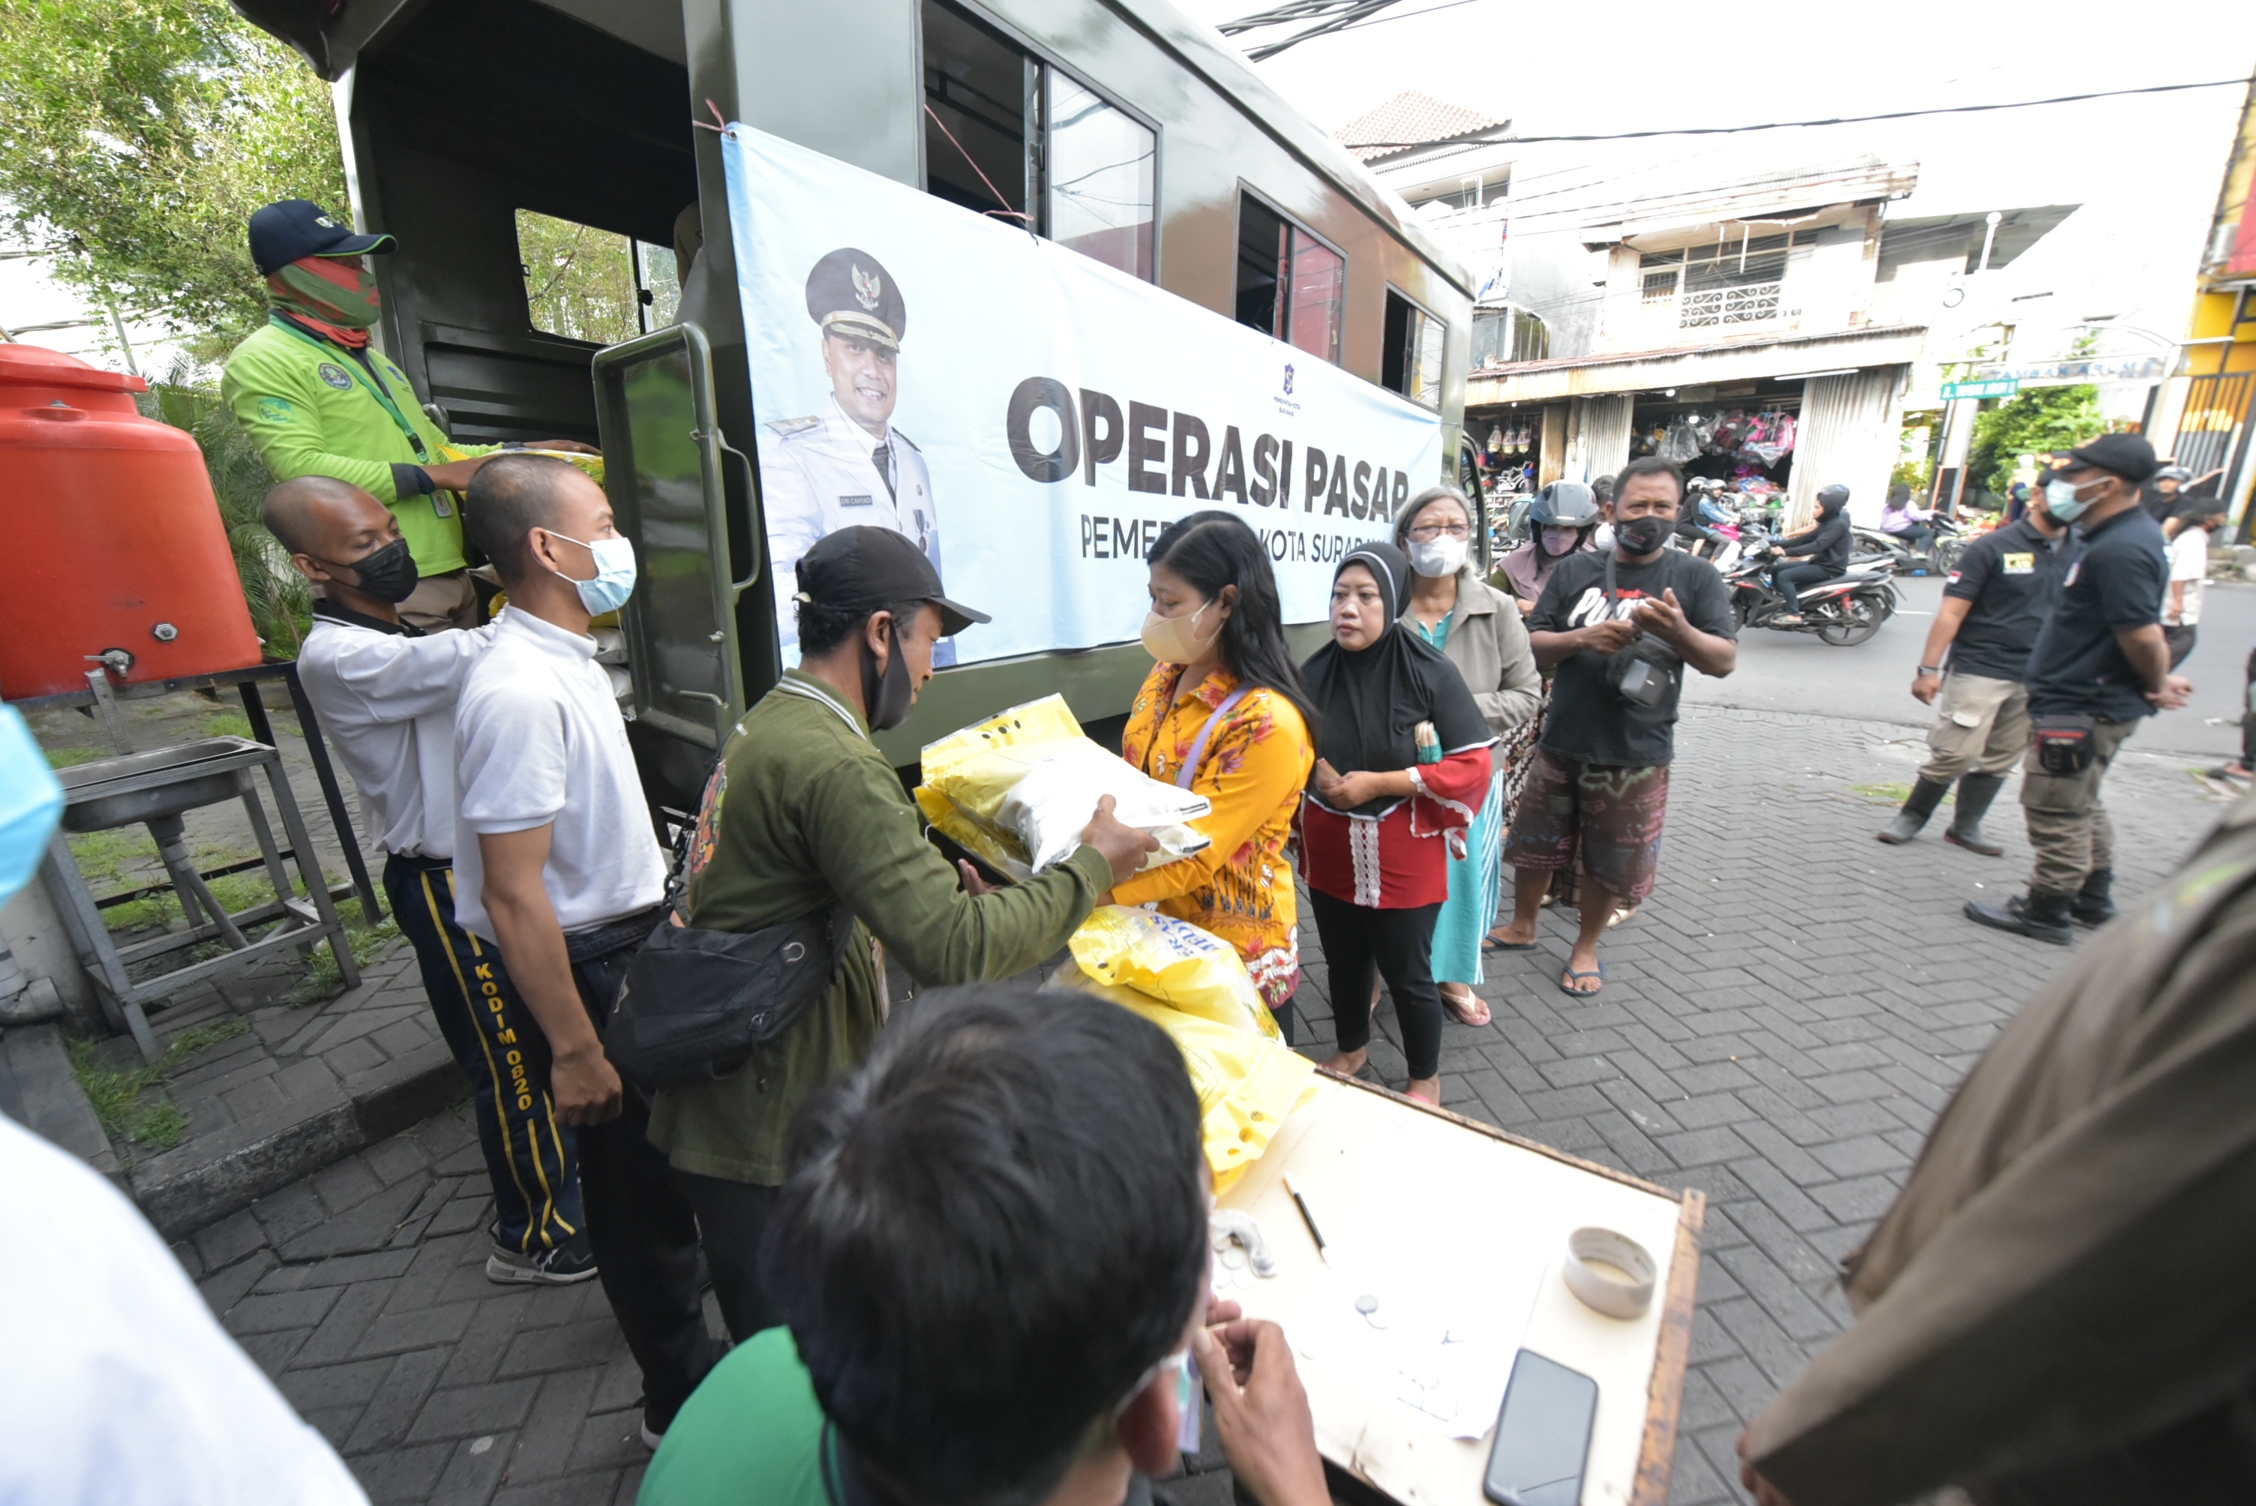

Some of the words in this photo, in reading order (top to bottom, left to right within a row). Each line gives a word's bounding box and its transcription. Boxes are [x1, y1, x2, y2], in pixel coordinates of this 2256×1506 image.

[1006, 376, 1293, 509] OPERASI
[1259, 528, 1307, 562] KOTA
[475, 962, 517, 1045] KODIM
[506, 1050, 532, 1111] 0820
